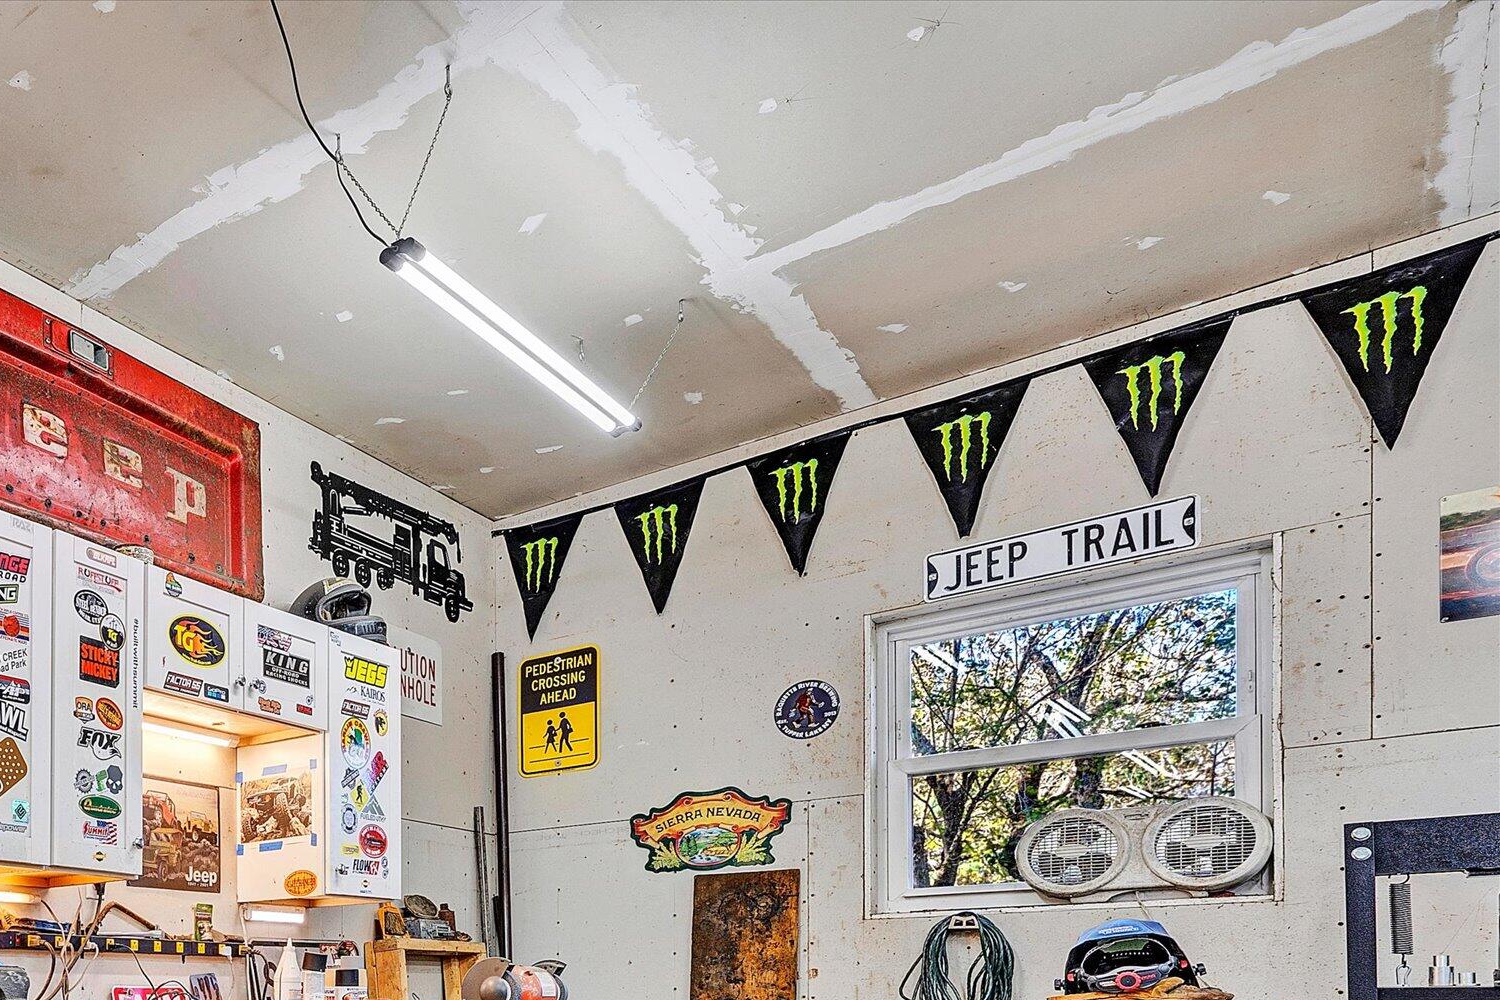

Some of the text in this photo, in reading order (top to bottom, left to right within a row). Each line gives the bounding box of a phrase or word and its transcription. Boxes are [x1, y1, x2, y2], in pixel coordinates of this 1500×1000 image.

[943, 509, 1175, 592] JEEP TRAIL
[2, 648, 28, 663] CREEK
[11, 659, 27, 672] Park
[80, 643, 119, 667] STICKY
[266, 651, 309, 674] KING
[400, 648, 436, 682] UTION
[525, 653, 592, 678] PEDESTRIAN
[81, 659, 119, 682] MICKEY
[345, 656, 388, 689] JEGS
[531, 670, 586, 692] CROSSING
[360, 685, 386, 702] KAIROS
[400, 674, 436, 707] NHOLE
[539, 687, 577, 706] AHEAD
[79, 728, 119, 752] FOX
[655, 807, 762, 833] SIERRA NEVADA
[185, 865, 218, 888] Jeep
